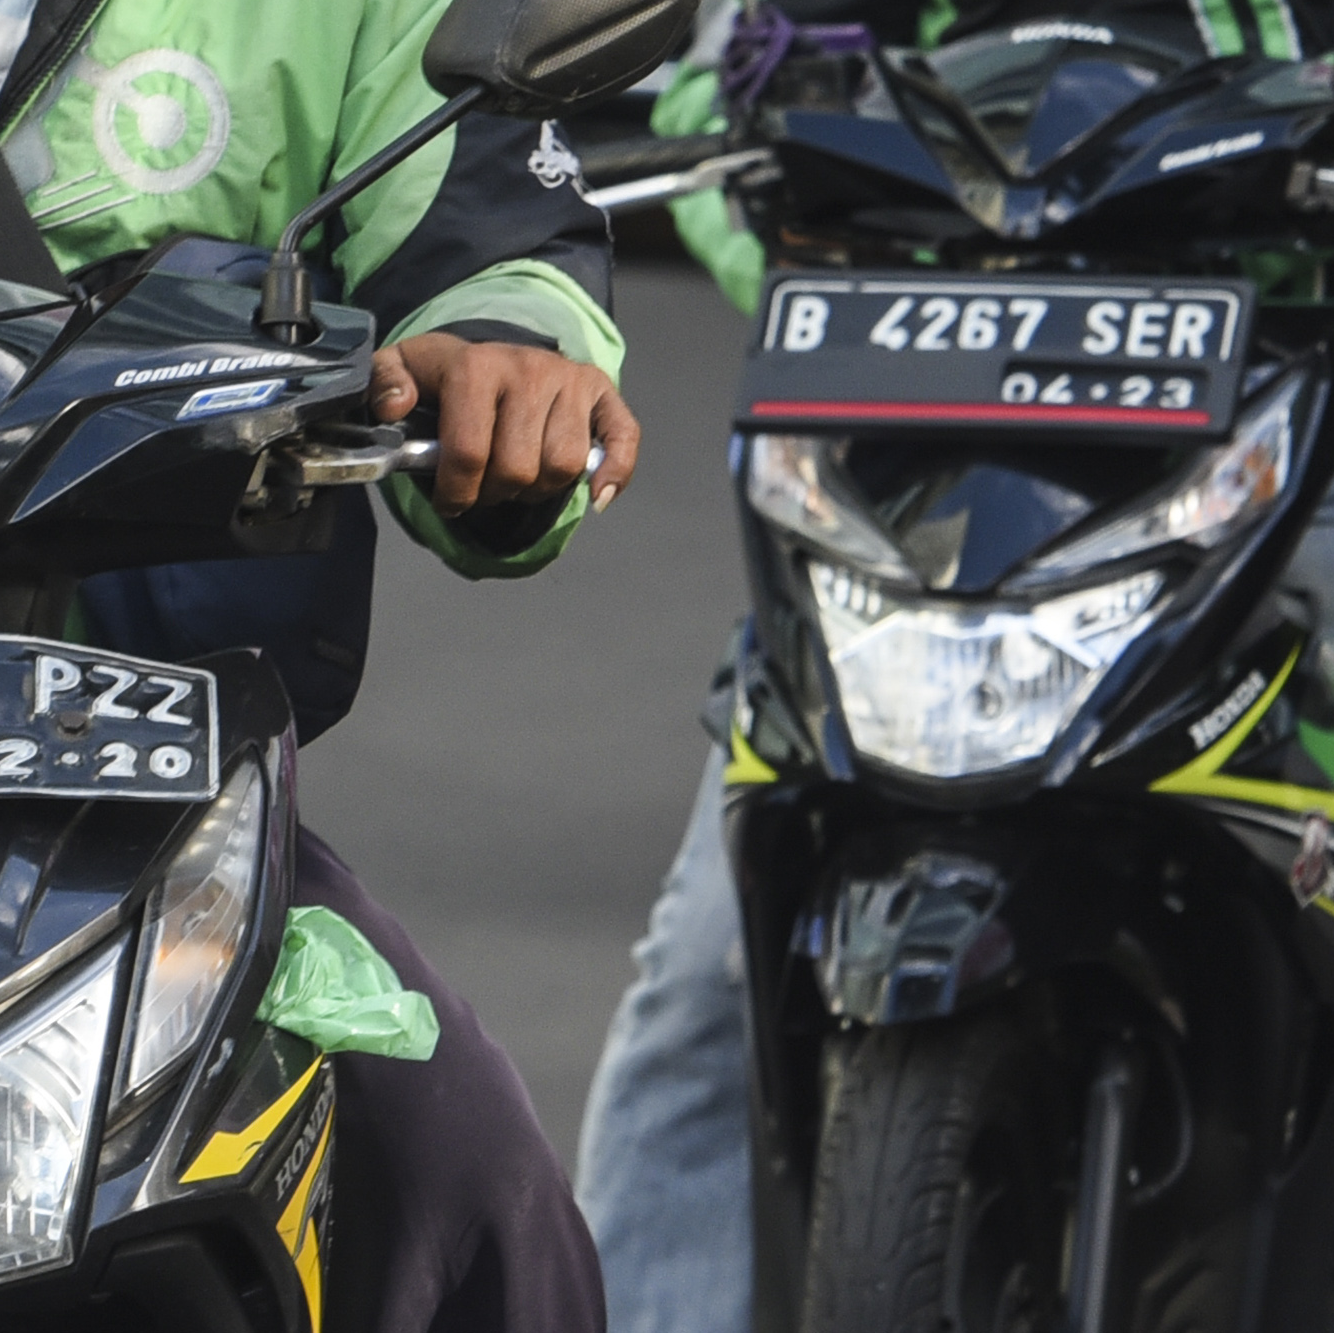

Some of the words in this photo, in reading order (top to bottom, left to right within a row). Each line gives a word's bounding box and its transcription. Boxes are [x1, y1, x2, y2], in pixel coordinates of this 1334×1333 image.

[782, 295, 830, 351] B
[869, 296, 1049, 352] 4267
[1082, 301, 1214, 359] SER
[114, 359, 209, 387] Combi
[33, 654, 194, 726] PZZ
